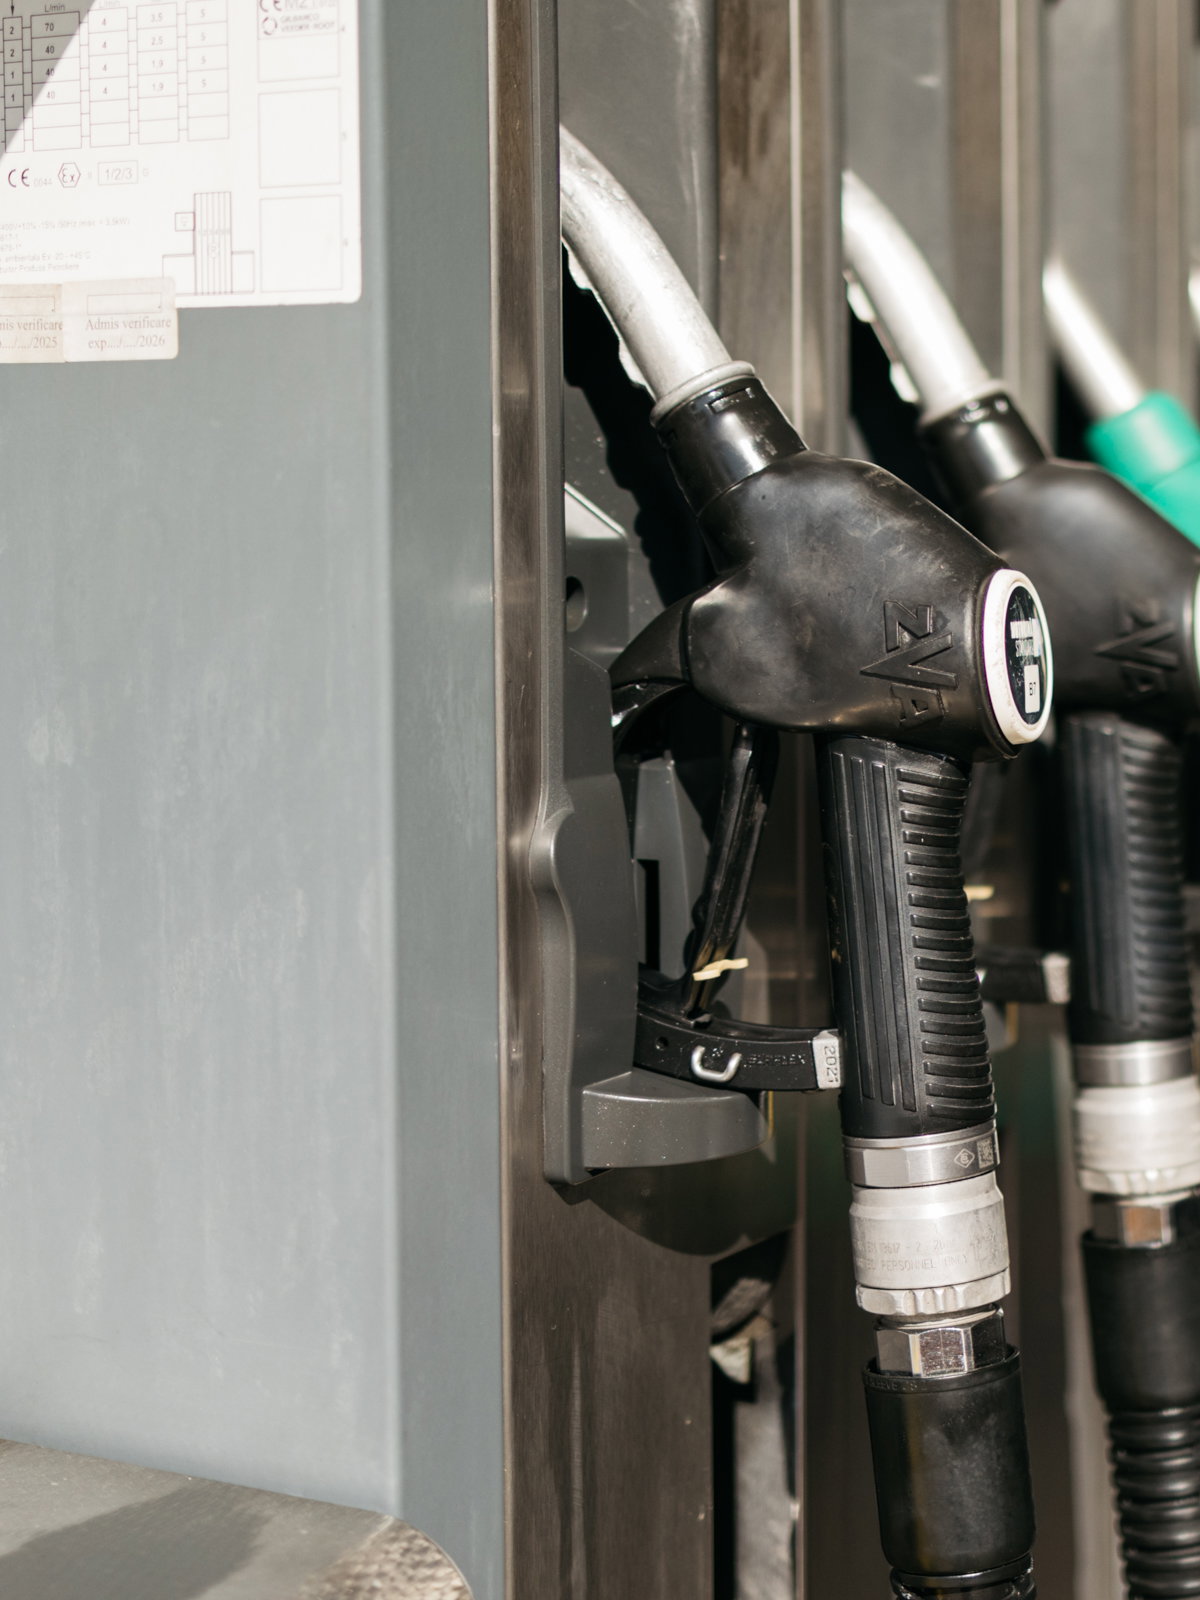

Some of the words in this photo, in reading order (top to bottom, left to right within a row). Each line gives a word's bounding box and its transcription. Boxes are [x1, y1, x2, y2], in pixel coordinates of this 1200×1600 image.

[44, 4, 65, 13] L/min
[9, 26, 15, 35] 2
[44, 23, 55, 32] 70
[101, 18, 107, 27] 4
[200, 9, 206, 18] 5
[10, 49, 15, 57] 2
[45, 45, 55, 54] 40
[102, 41, 107, 49] 4
[200, 32, 206, 41] 5
[11, 71, 15, 79] 1
[46, 67, 55, 77] 40
[102, 64, 108, 72] 4
[201, 55, 207, 64] 5
[11, 93, 15, 102] 1
[47, 90, 56, 100] 40
[103, 87, 108, 95] 4
[201, 78, 207, 88] 5
[8, 168, 30, 188] CE
[105, 168, 133, 182] 1/2/3
[17, 318, 63, 331] verificare
[85, 319, 122, 331] Admis
[123, 316, 172, 329] verificare
